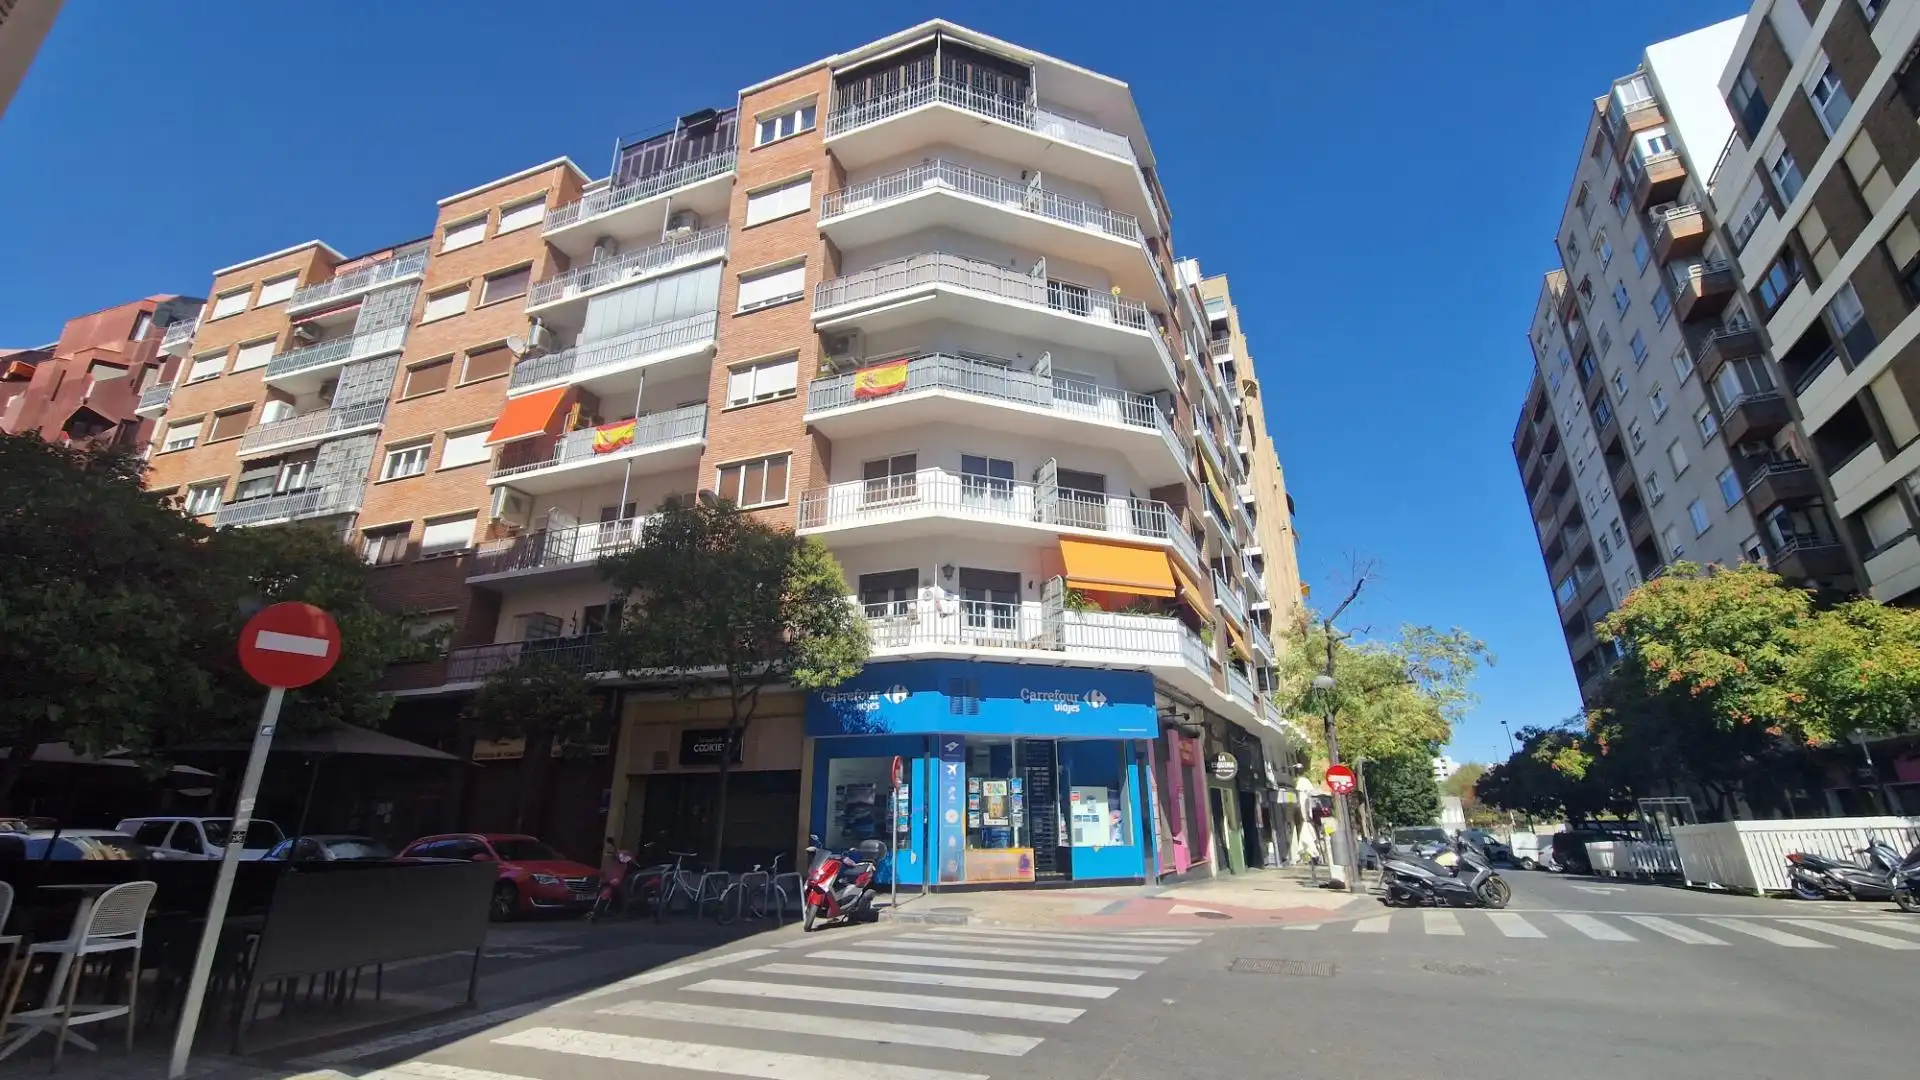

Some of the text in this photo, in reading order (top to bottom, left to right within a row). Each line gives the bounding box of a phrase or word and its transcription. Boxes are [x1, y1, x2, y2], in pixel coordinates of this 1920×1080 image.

[1020, 688, 1079, 703] Carrefour
[1053, 702, 1080, 714] viajes
[693, 743, 726, 753] COOKIE
